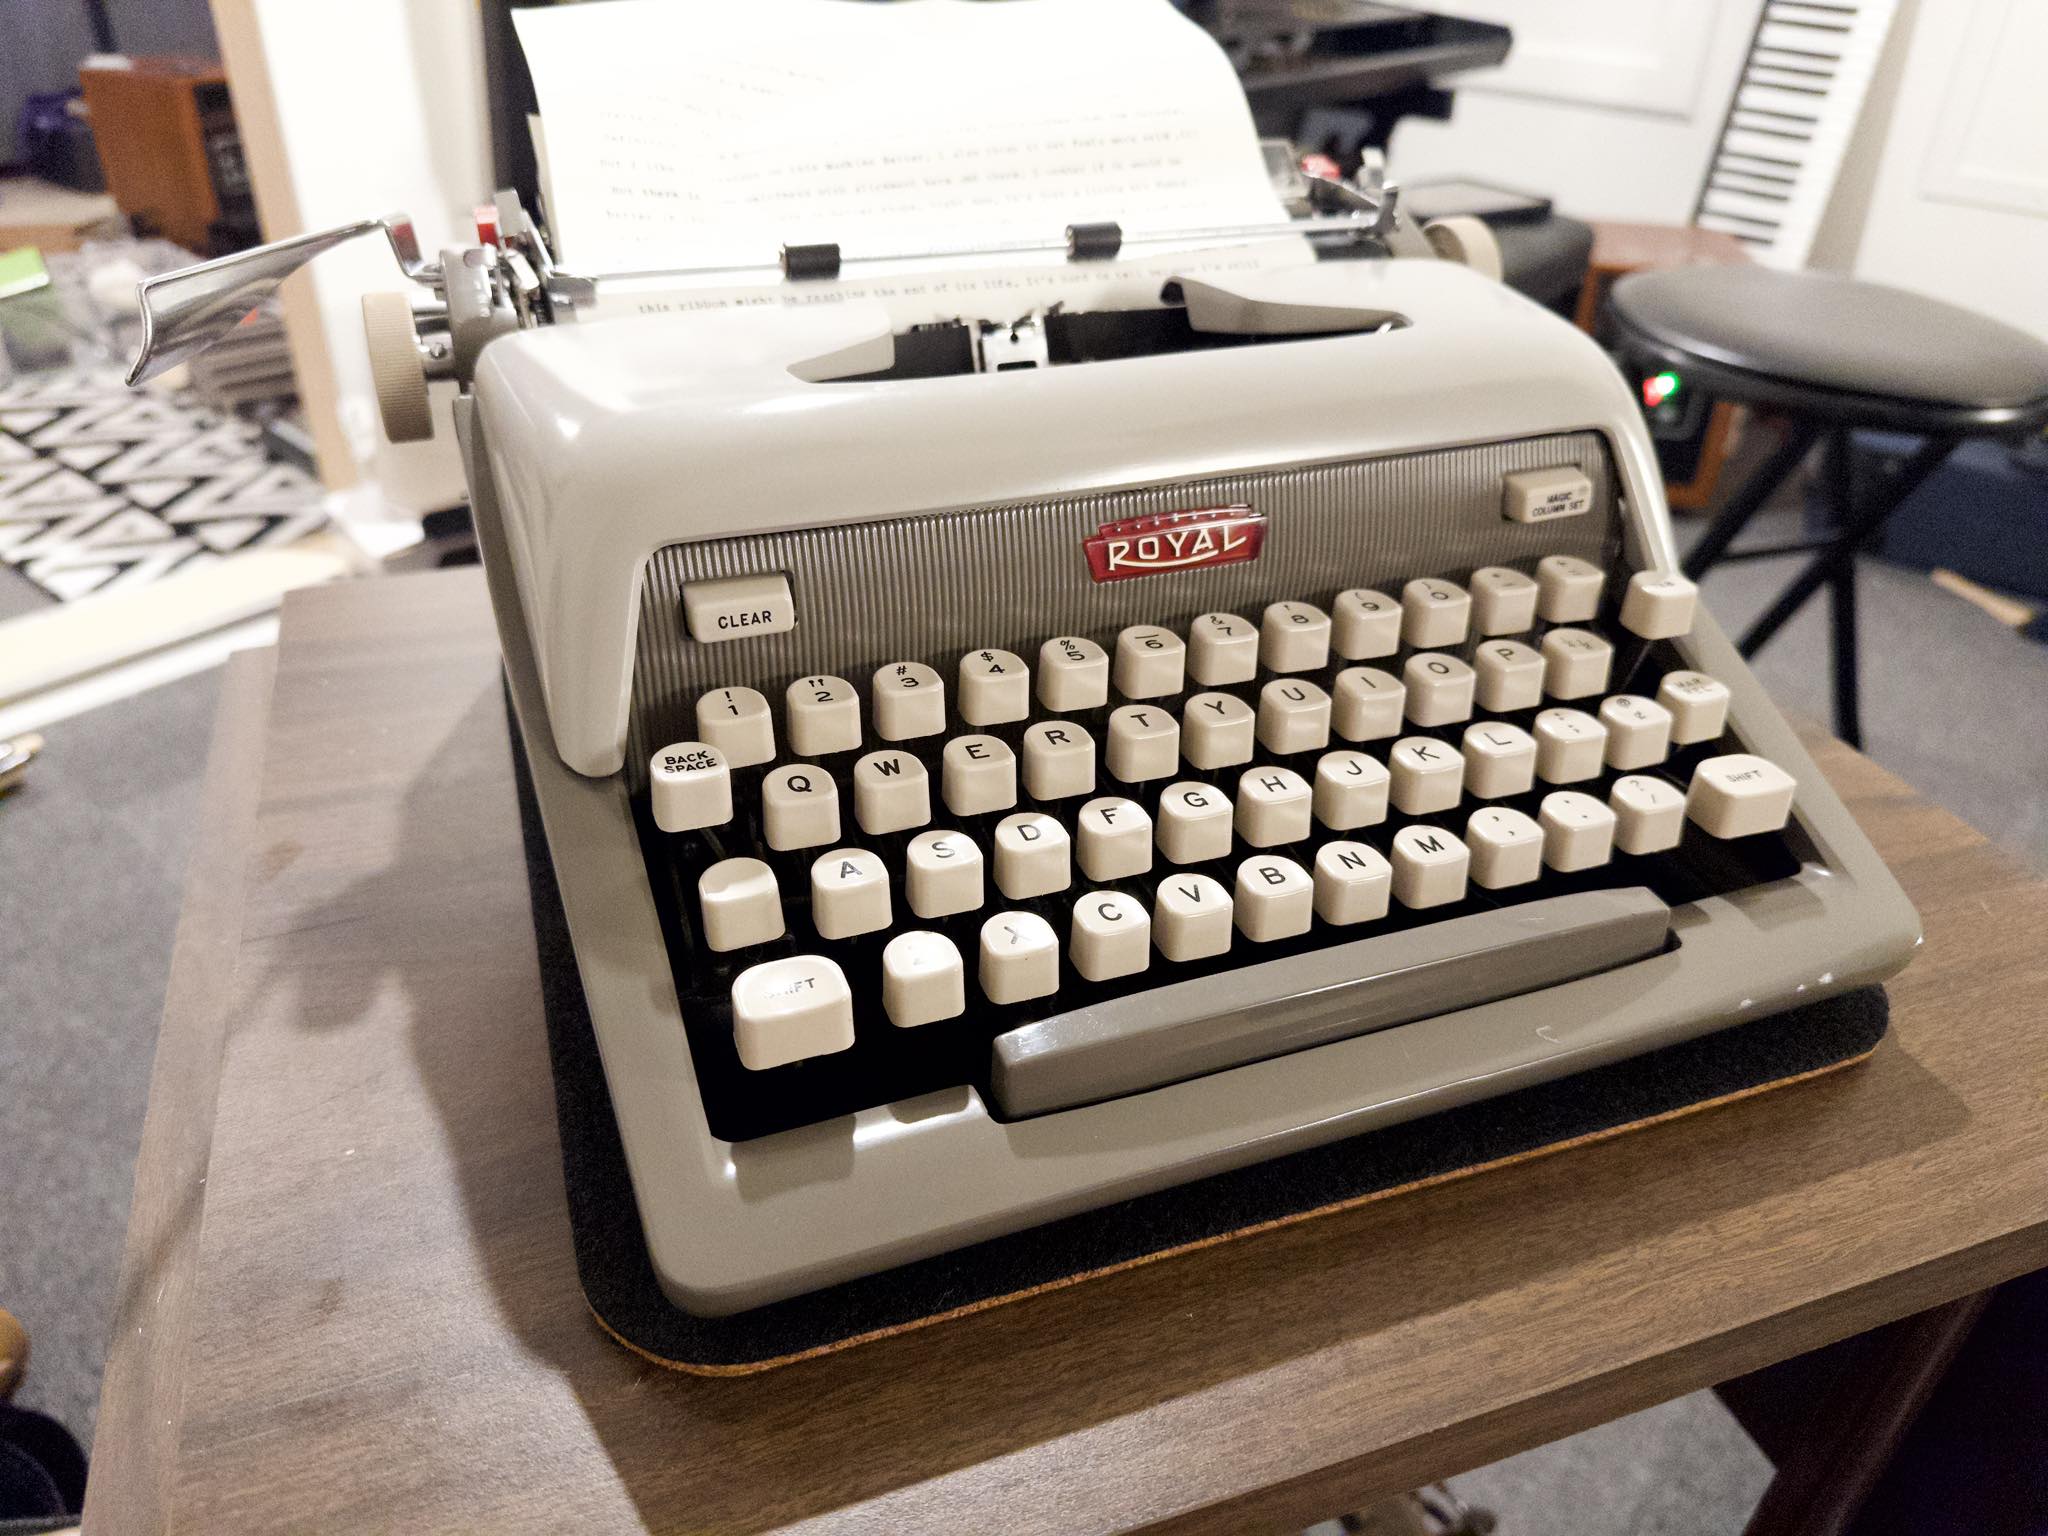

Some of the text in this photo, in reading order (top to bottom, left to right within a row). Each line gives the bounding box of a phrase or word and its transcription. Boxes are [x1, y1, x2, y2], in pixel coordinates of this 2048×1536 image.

[638, 300, 671, 315] this
[679, 295, 728, 312] ribbon
[1546, 491, 1573, 503] MAGIC
[1531, 499, 1585, 517] COLUMN SET
[1108, 526, 1248, 571] ROYAL
[1363, 601, 1380, 612] 9
[717, 610, 773, 630] CLEAR
[1291, 614, 1308, 625] 8
[1217, 625, 1232, 636] 7
[1059, 639, 1076, 651] %
[1145, 639, 1163, 650] 6
[981, 651, 994, 663] $
[1067, 651, 1086, 662] 5
[1496, 648, 1514, 661] P
[897, 666, 907, 676] #
[990, 664, 1006, 673] 4
[902, 678, 919, 689] 3
[1361, 676, 1377, 689] I
[816, 691, 832, 702] 2
[1281, 687, 1306, 701] U
[728, 704, 740, 715] 1
[1204, 700, 1226, 715] Y
[1130, 713, 1149, 728] T
[1045, 730, 1071, 745] R
[1484, 733, 1512, 746] L
[664, 750, 709, 765] BACK
[965, 743, 991, 760] E
[1412, 746, 1440, 761] K
[663, 758, 717, 774] SPACE
[873, 758, 901, 777] W
[1346, 760, 1363, 775] J
[1725, 769, 1761, 783] SHIFT
[787, 775, 812, 793] Q
[1260, 776, 1287, 793] H
[1183, 792, 1209, 808] G
[1099, 806, 1118, 825] F
[1016, 824, 1042, 842] D
[931, 841, 956, 859] S
[1415, 835, 1445, 854] M
[1337, 851, 1367, 870] N
[840, 861, 863, 879] A
[1259, 867, 1286, 885] B
[1178, 884, 1201, 903] V
[1097, 903, 1123, 921] C
[1003, 925, 1032, 945] X
